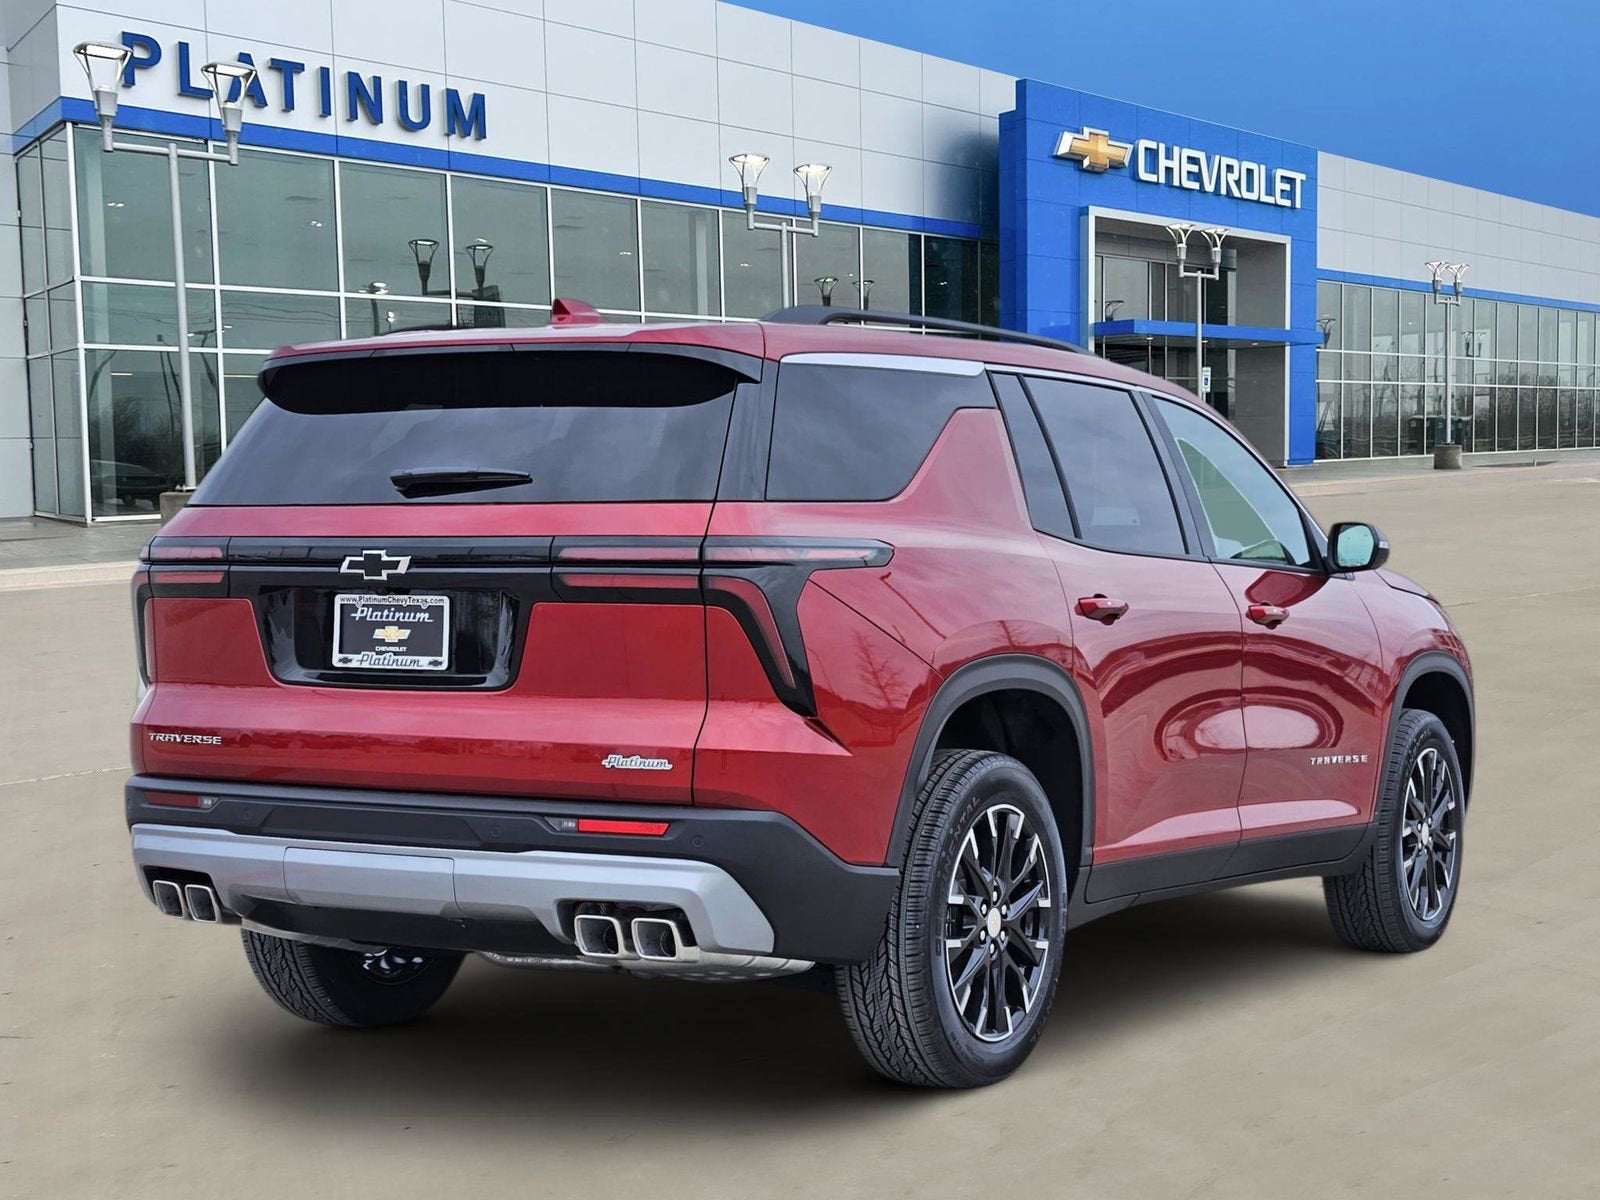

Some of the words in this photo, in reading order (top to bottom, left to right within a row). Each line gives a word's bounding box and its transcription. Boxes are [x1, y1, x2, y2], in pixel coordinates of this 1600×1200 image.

[120, 31, 486, 141] PLATINUM
[1136, 138, 1306, 209] CHEVROLET
[340, 596, 444, 605] www.PlatinumChevyTexas.com
[350, 607, 434, 623] Platinum
[356, 652, 424, 668] Platinum
[148, 732, 222, 746] TRAVERSE
[602, 755, 673, 769] Platinum
[1310, 755, 1368, 765] TRAVERSE
